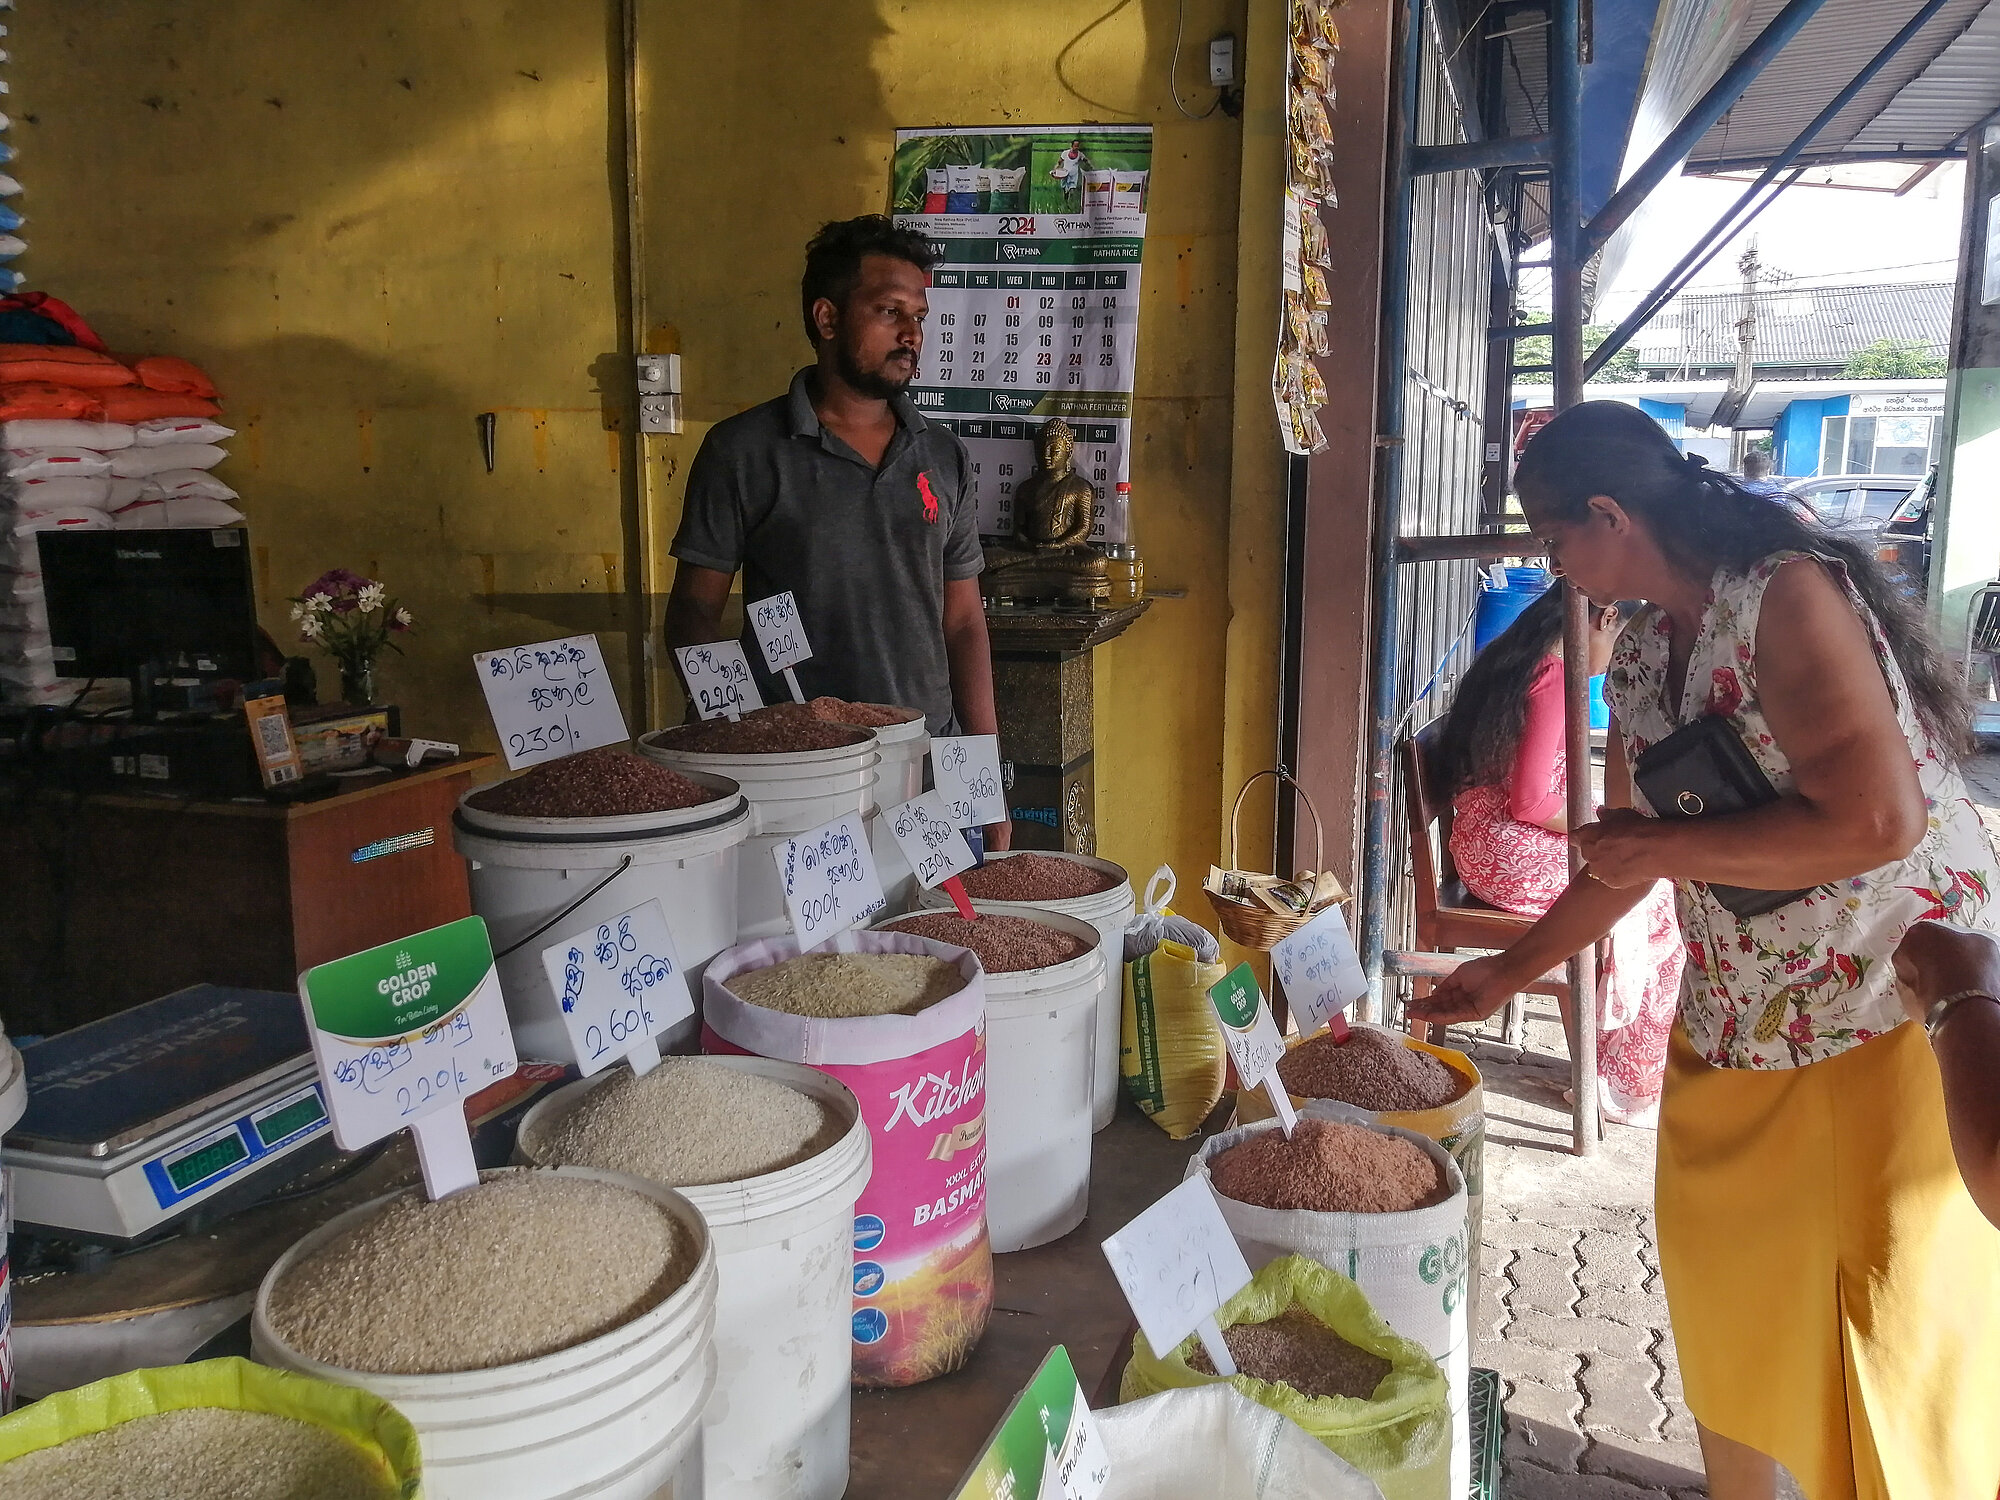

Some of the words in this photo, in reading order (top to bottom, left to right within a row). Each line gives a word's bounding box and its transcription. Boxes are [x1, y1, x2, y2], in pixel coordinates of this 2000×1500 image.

[898, 218, 931, 231] RATHNA
[997, 216, 1037, 236] 2024
[1056, 218, 1091, 233] RATHNA
[930, 243, 946, 256] AY
[1003, 244, 1041, 260] RATHNA
[1093, 249, 1120, 258] RATHNA
[1121, 248, 1138, 257] RICE
[940, 275, 958, 284] MON
[975, 275, 989, 285] TUE
[1006, 276, 1023, 285] WED
[1041, 276, 1056, 286] THU
[1075, 276, 1086, 285] FRI
[1104, 276, 1118, 285] SAT
[1007, 296, 1020, 309] 01
[1040, 296, 1054, 309] 02
[1072, 296, 1086, 310] 03
[1103, 296, 1116, 310] 04
[940, 313, 956, 326] 06
[974, 314, 987, 327] 07
[1005, 314, 1020, 327] 08
[1038, 315, 1053, 328] 09
[1071, 315, 1083, 328] 10
[1103, 315, 1114, 328] 11
[941, 332, 953, 344] 13
[973, 332, 986, 345] 14
[1005, 333, 1019, 346] 15
[1038, 334, 1052, 347] 16
[1071, 334, 1083, 347] 17
[1101, 334, 1113, 348] 18
[940, 350, 953, 363] 20
[972, 350, 985, 363] 21
[1004, 351, 1018, 365] 22
[1036, 352, 1051, 366] 23
[1068, 353, 1082, 366] 24
[1099, 353, 1113, 367] 25
[940, 368, 953, 381] 27
[970, 369, 984, 382] 28
[1003, 370, 1018, 383] 29
[1036, 371, 1051, 384] 30
[1068, 372, 1080, 385] 31
[914, 391, 945, 407] JUNE
[995, 394, 1034, 410] RATHNA
[1060, 402, 1089, 411] RATHNA
[1089, 402, 1127, 412] FERTILIZER
[969, 424, 982, 434] TUE
[1000, 425, 1016, 435] WED
[1095, 429, 1108, 439] SAT
[1095, 449, 1107, 463] 01
[999, 463, 1013, 476] 05
[1093, 468, 1107, 481] 08
[999, 481, 1011, 494] 12
[1094, 486, 1105, 500] 15
[998, 499, 1011, 512] 19
[1093, 505, 1105, 518] 22
[996, 517, 1010, 530] 26
[1092, 522, 1105, 536] 29
[377, 961, 438, 994] GOLDEN
[391, 980, 431, 1007] CROP
[1144, 1034, 1154, 1059] NADU
[492, 1062, 505, 1076] CIC
[945, 1168, 968, 1189] XXXL
